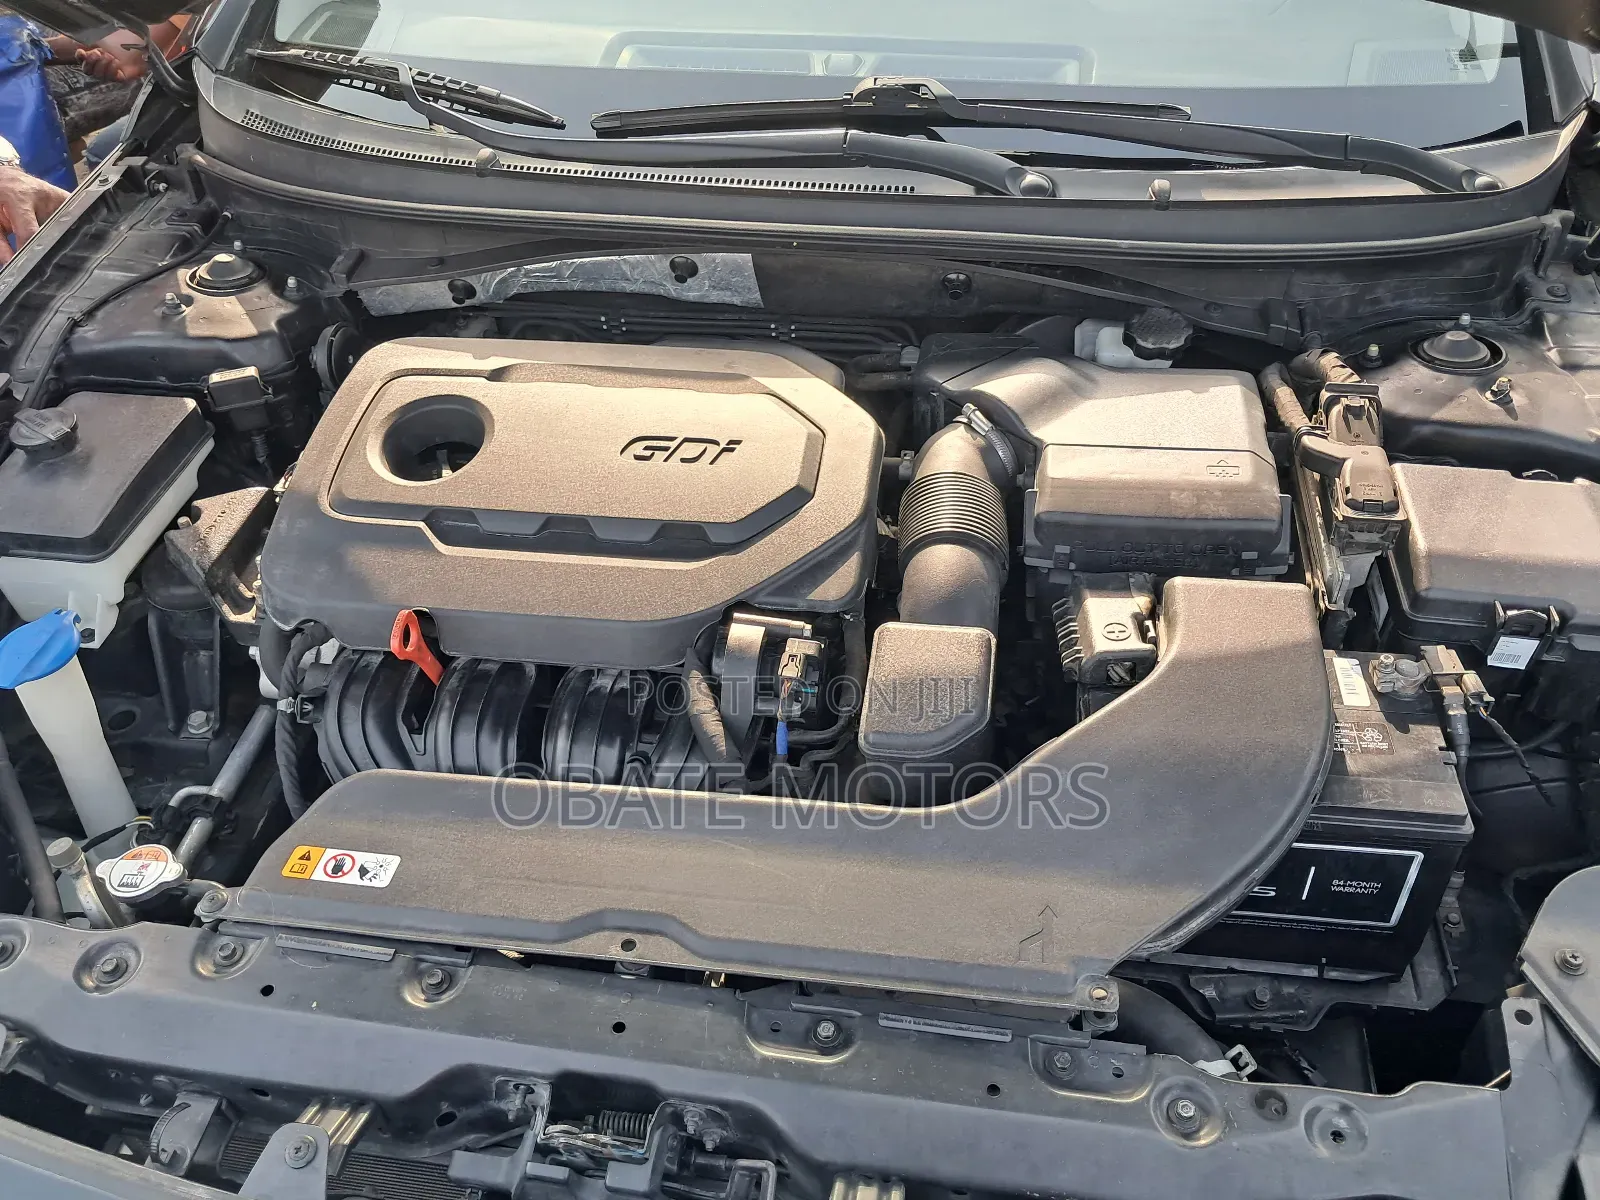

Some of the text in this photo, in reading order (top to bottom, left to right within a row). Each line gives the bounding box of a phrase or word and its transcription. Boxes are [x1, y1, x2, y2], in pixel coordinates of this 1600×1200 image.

[1121, 541, 1158, 555] OUT
[1162, 543, 1185, 555] TO
[1189, 543, 1238, 557] OPEN
[1332, 880, 1381, 889] 84-MONTH
[1331, 885, 1379, 895] WARRANTY
